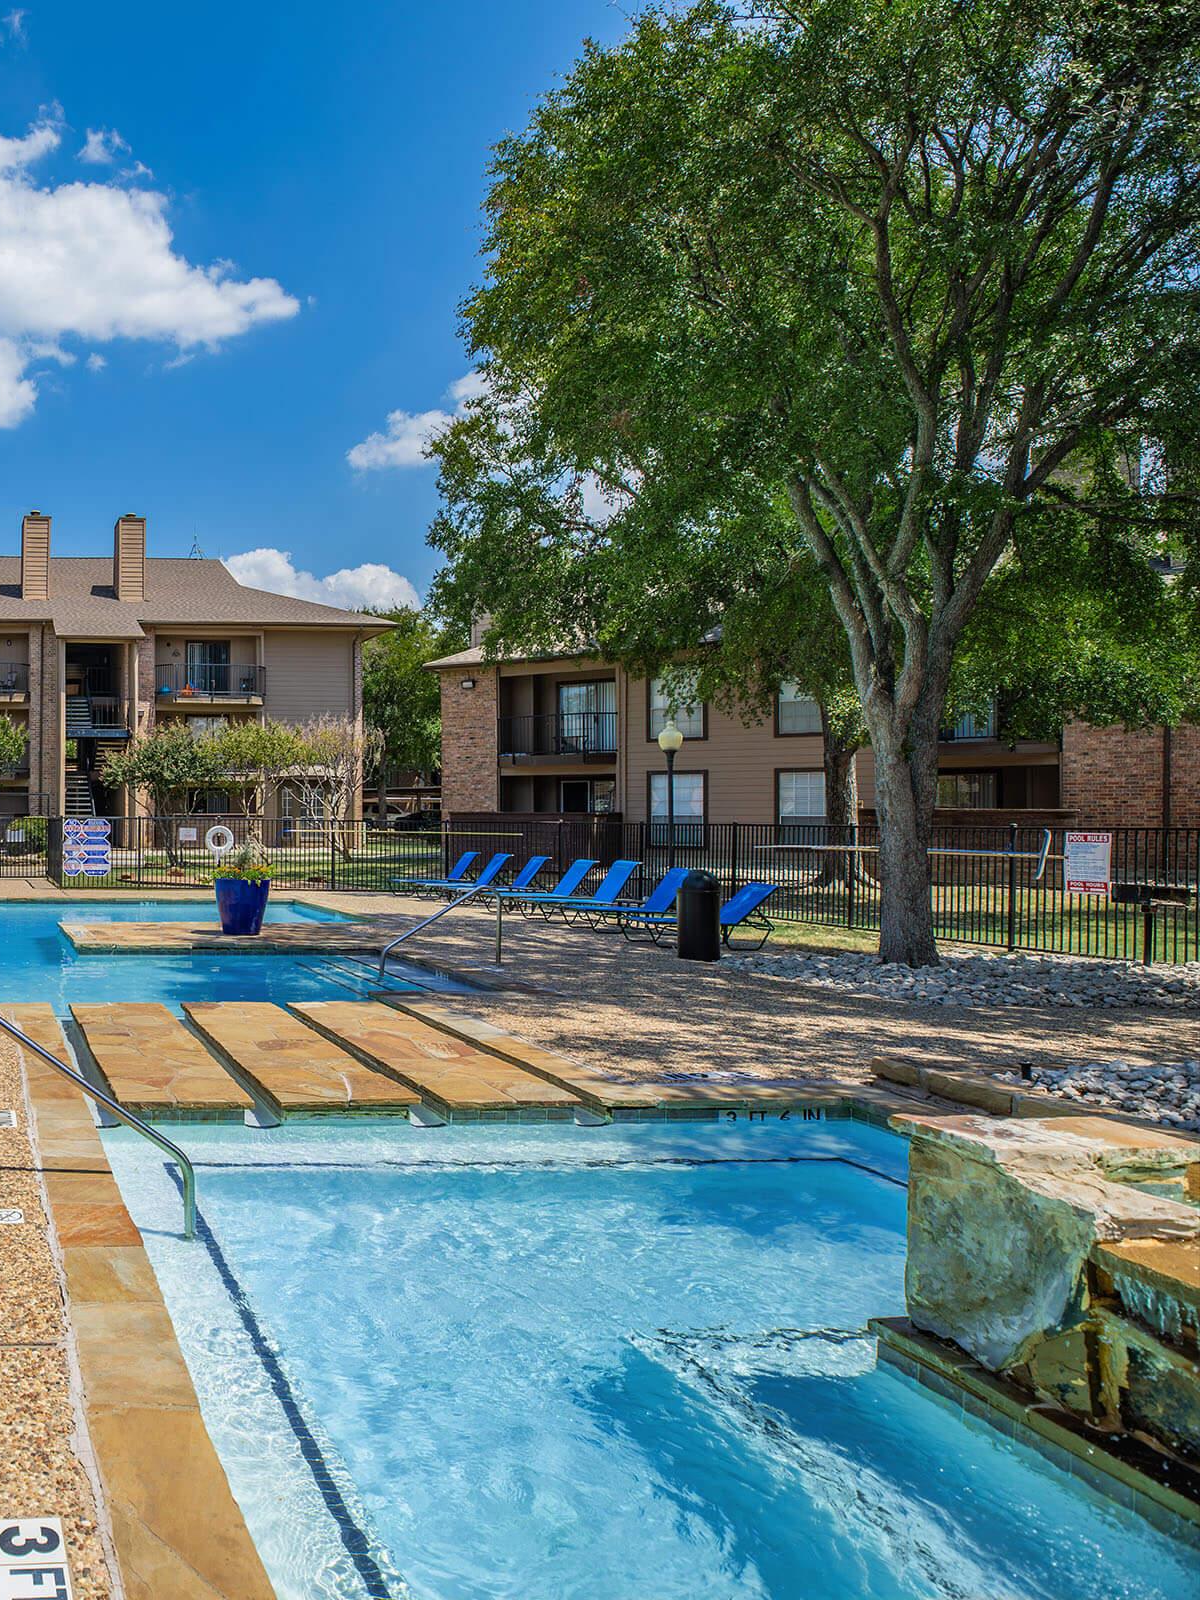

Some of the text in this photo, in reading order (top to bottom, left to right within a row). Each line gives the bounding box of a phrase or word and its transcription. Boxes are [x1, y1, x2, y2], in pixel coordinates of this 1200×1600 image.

[726, 1111, 737, 1122] 3
[803, 1109, 821, 1120] IN
[0, 1525, 60, 1557] 3
